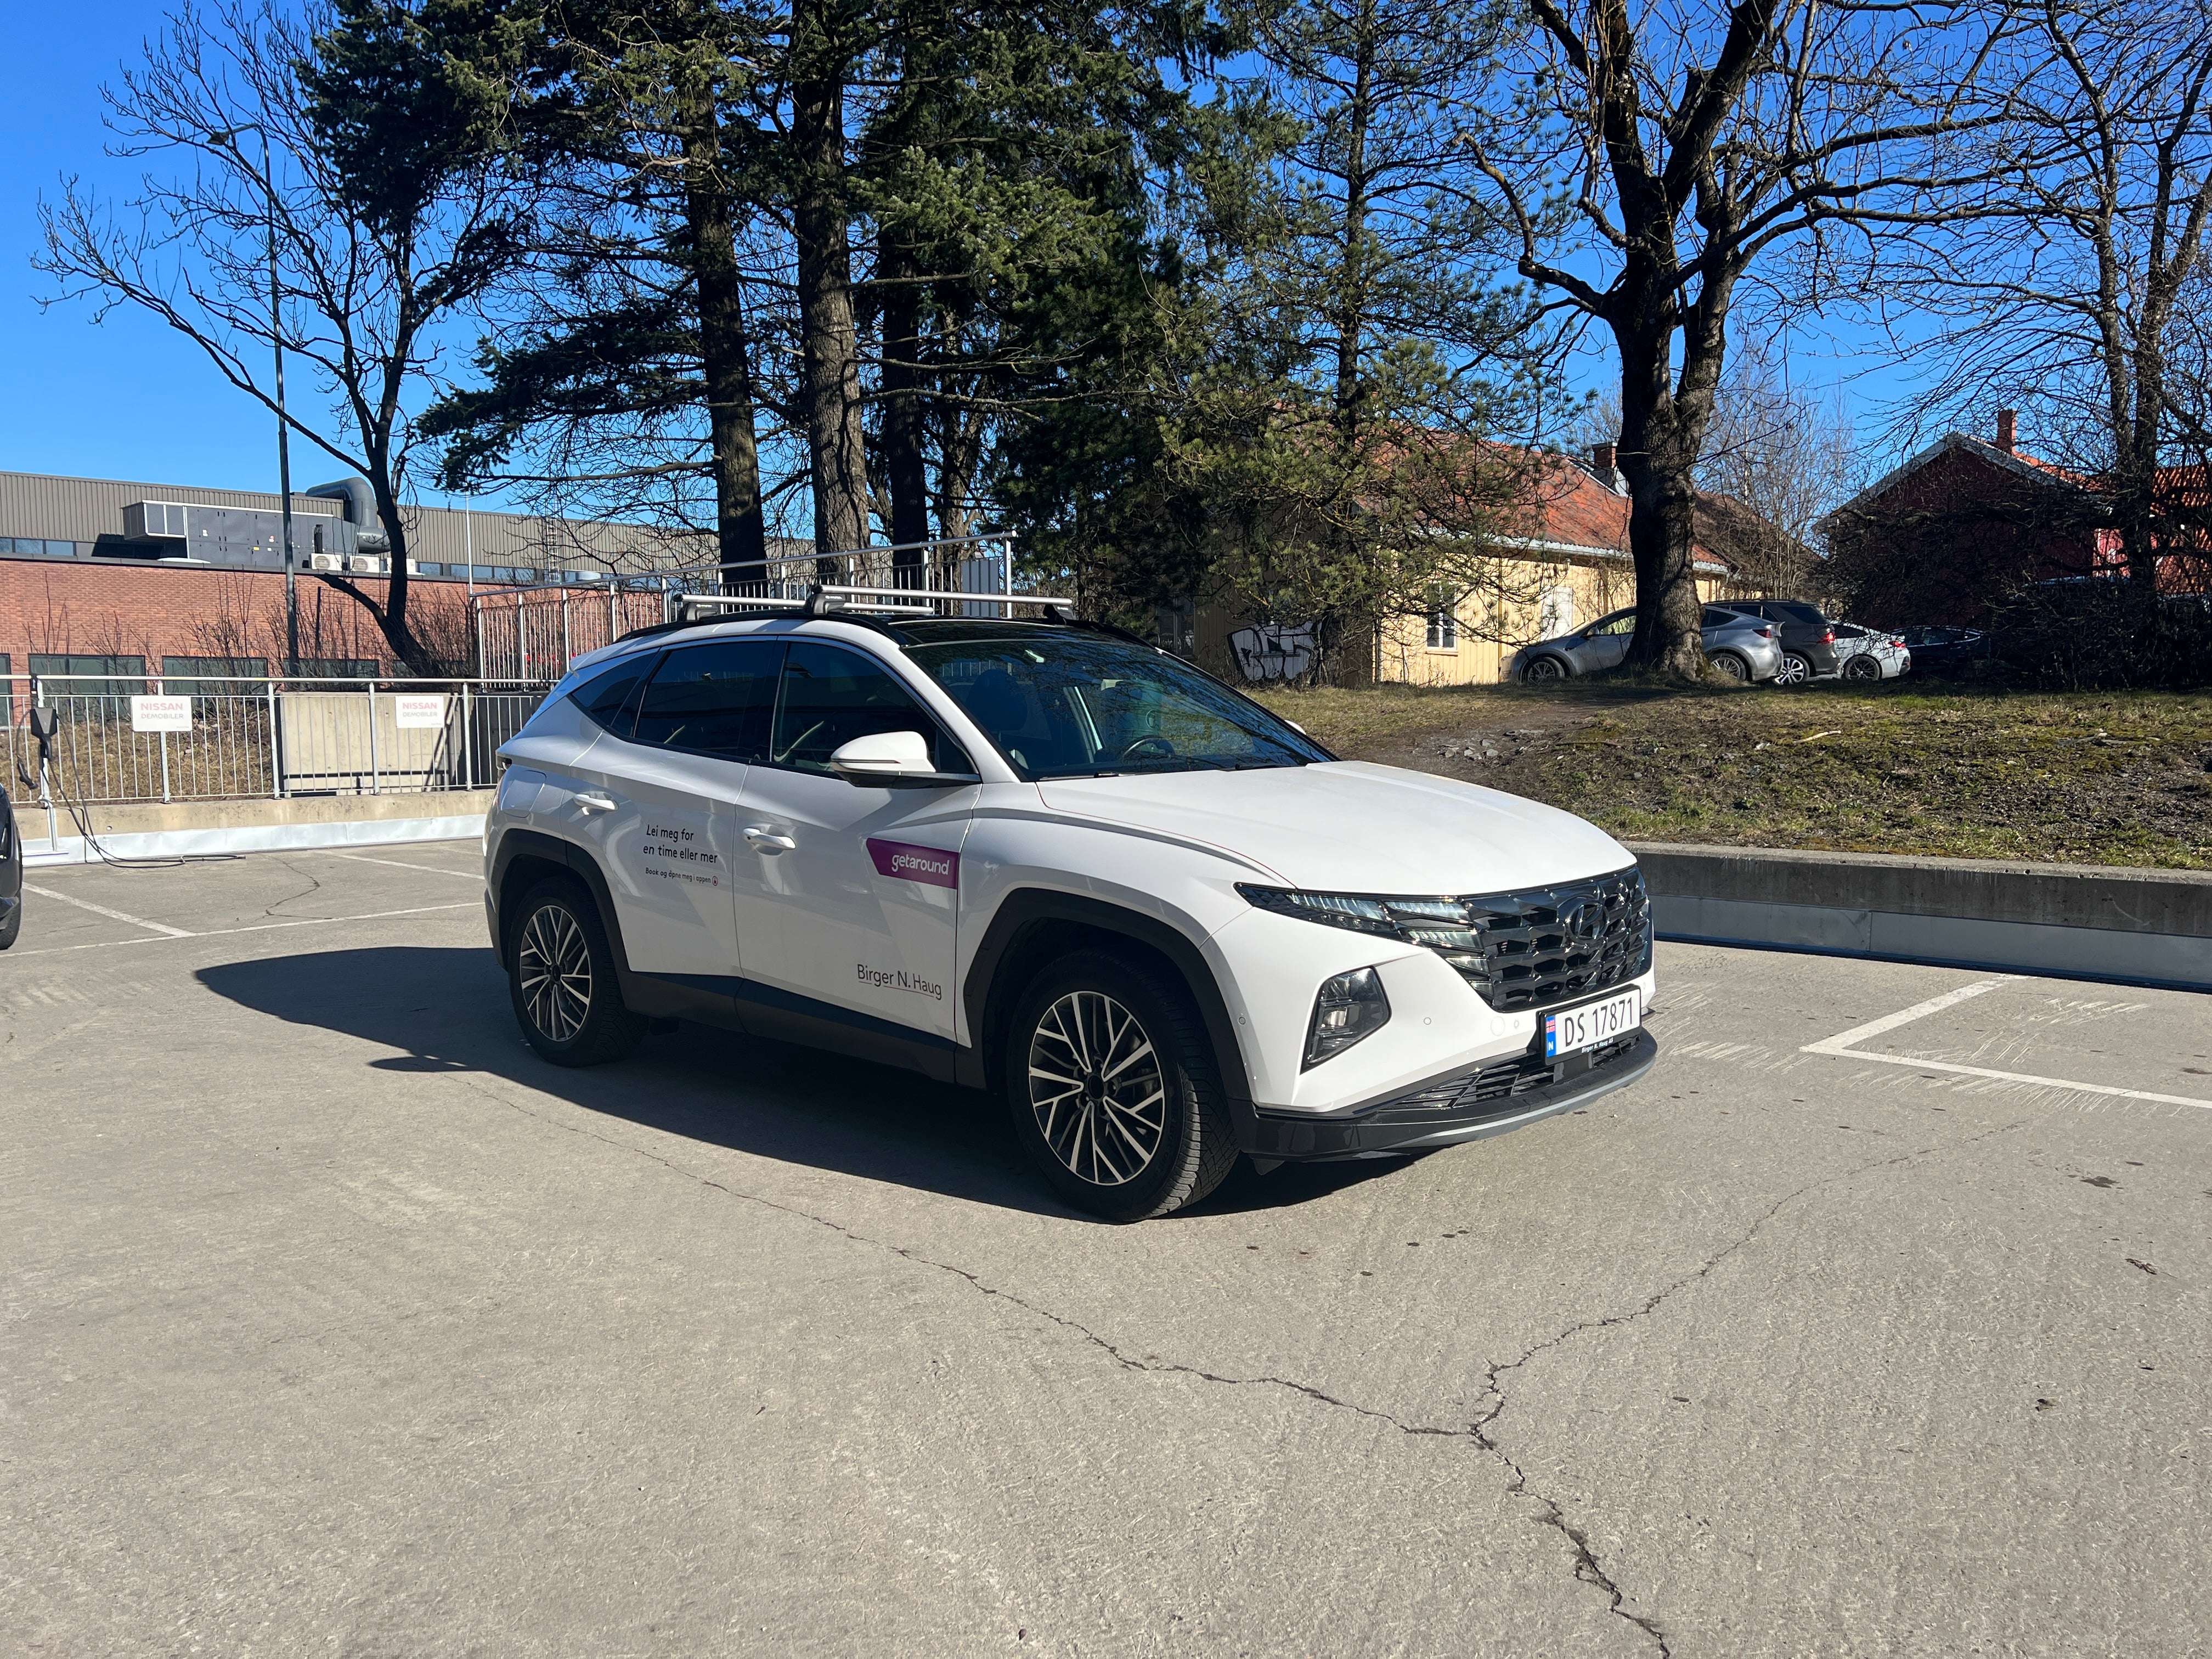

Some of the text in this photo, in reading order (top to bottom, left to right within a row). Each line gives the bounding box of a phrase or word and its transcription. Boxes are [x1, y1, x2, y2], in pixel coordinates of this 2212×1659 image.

[646, 824, 694, 843] Lei meg for
[643, 844, 718, 863] en time eller mer
[891, 854, 950, 875] getaround
[668, 870, 681, 879] åpne
[857, 964, 942, 1001] Birger N. Haug
[1565, 997, 1633, 1047] DS 17871
[1548, 1041, 1554, 1051] N
